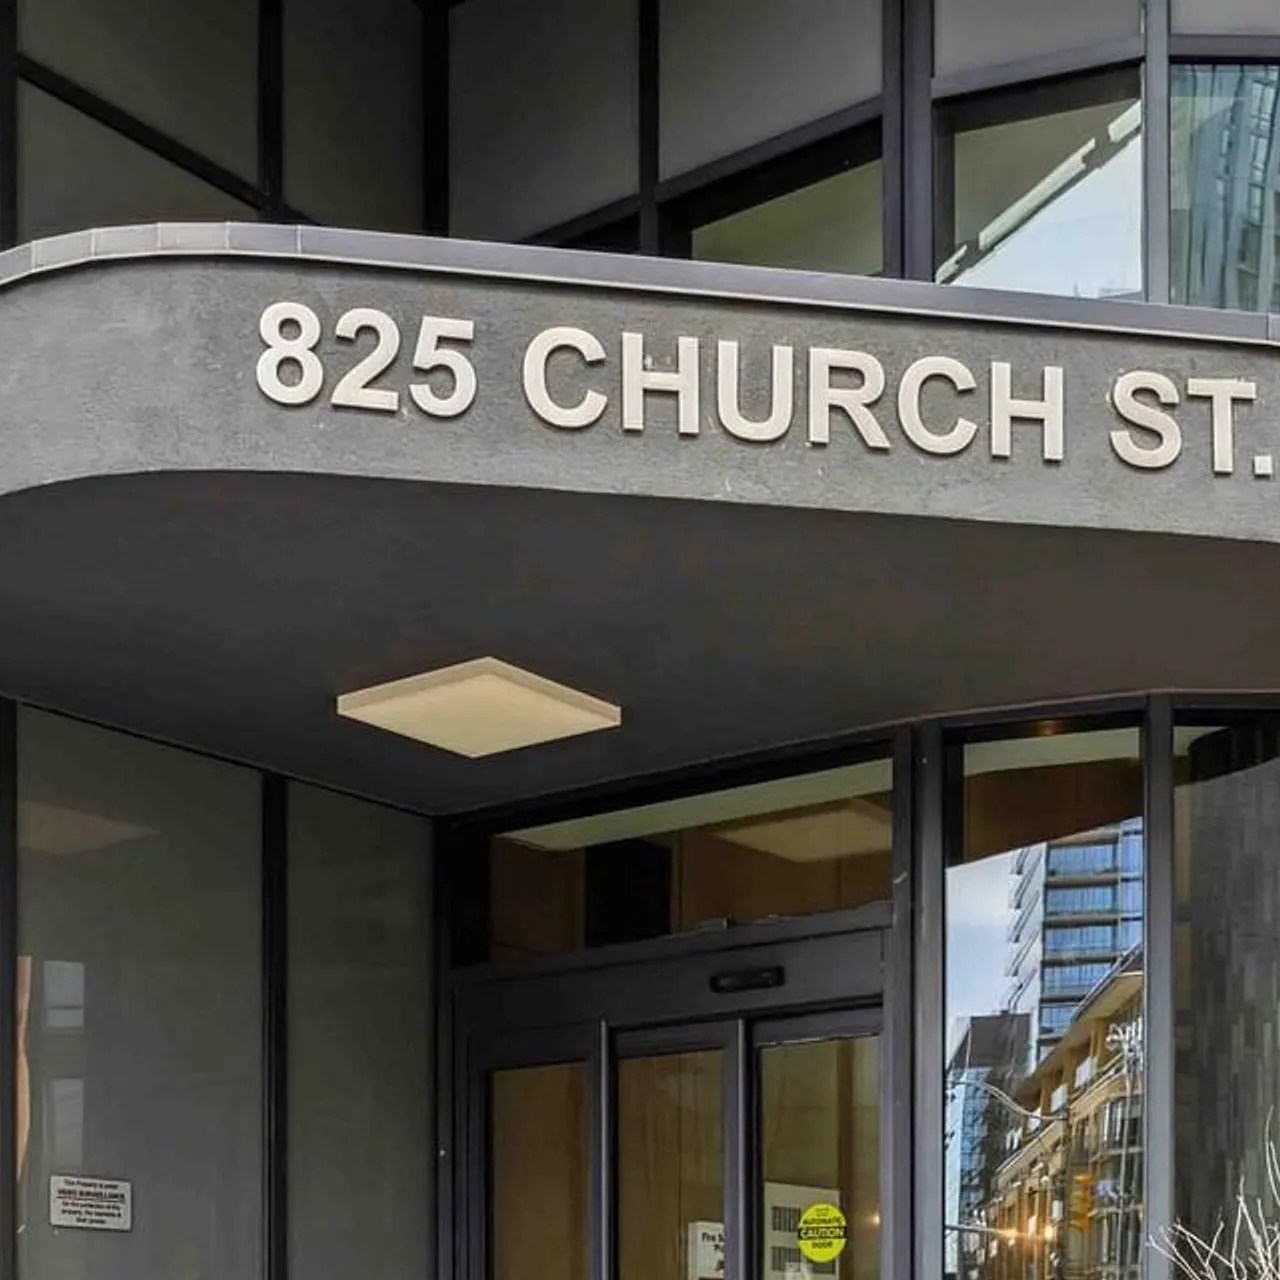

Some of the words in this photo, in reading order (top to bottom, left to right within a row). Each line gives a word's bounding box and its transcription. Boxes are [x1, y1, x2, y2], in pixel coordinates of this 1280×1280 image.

[255, 301, 479, 418] 825
[522, 325, 1065, 463] CHURCH
[1109, 369, 1273, 477] ST.
[800, 1228, 844, 1239] CAUTION
